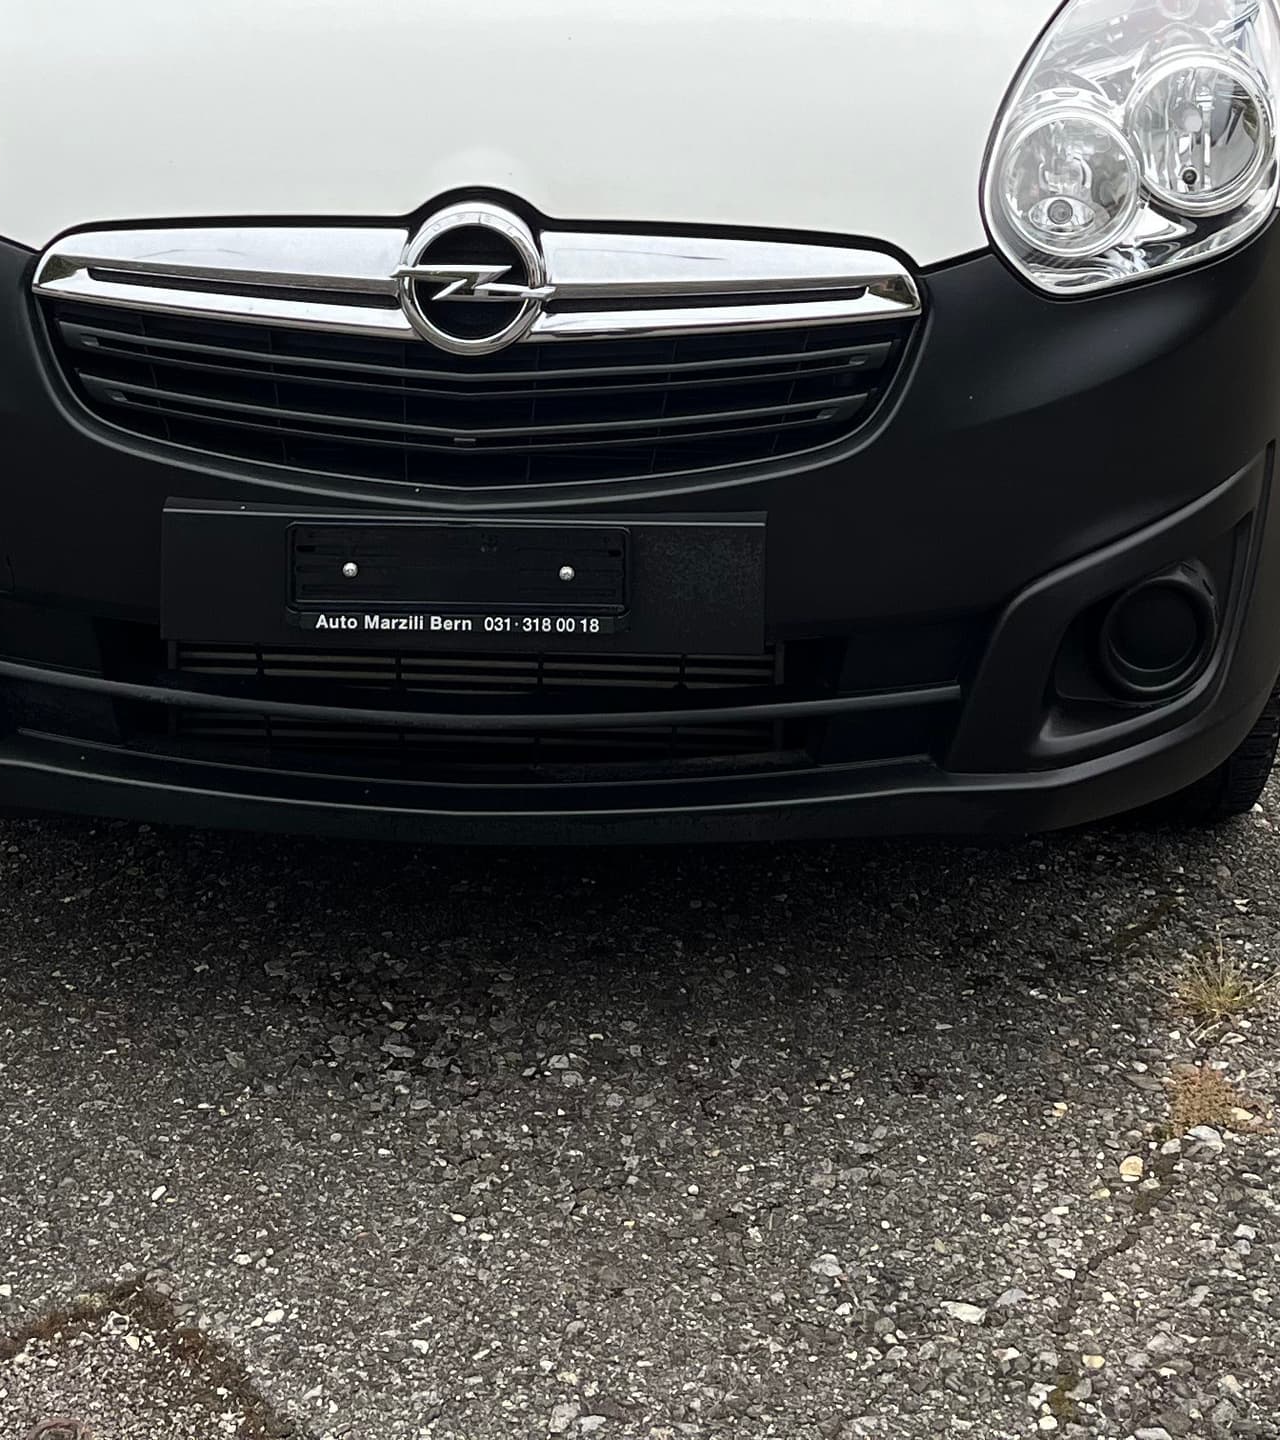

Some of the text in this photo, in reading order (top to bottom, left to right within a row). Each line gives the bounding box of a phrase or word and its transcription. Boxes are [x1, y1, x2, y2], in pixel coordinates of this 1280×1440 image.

[316, 615, 357, 630] Auto
[365, 615, 424, 631] Marzili
[430, 616, 472, 631] Bern
[556, 618, 575, 633] 00
[580, 618, 599, 633] 18
